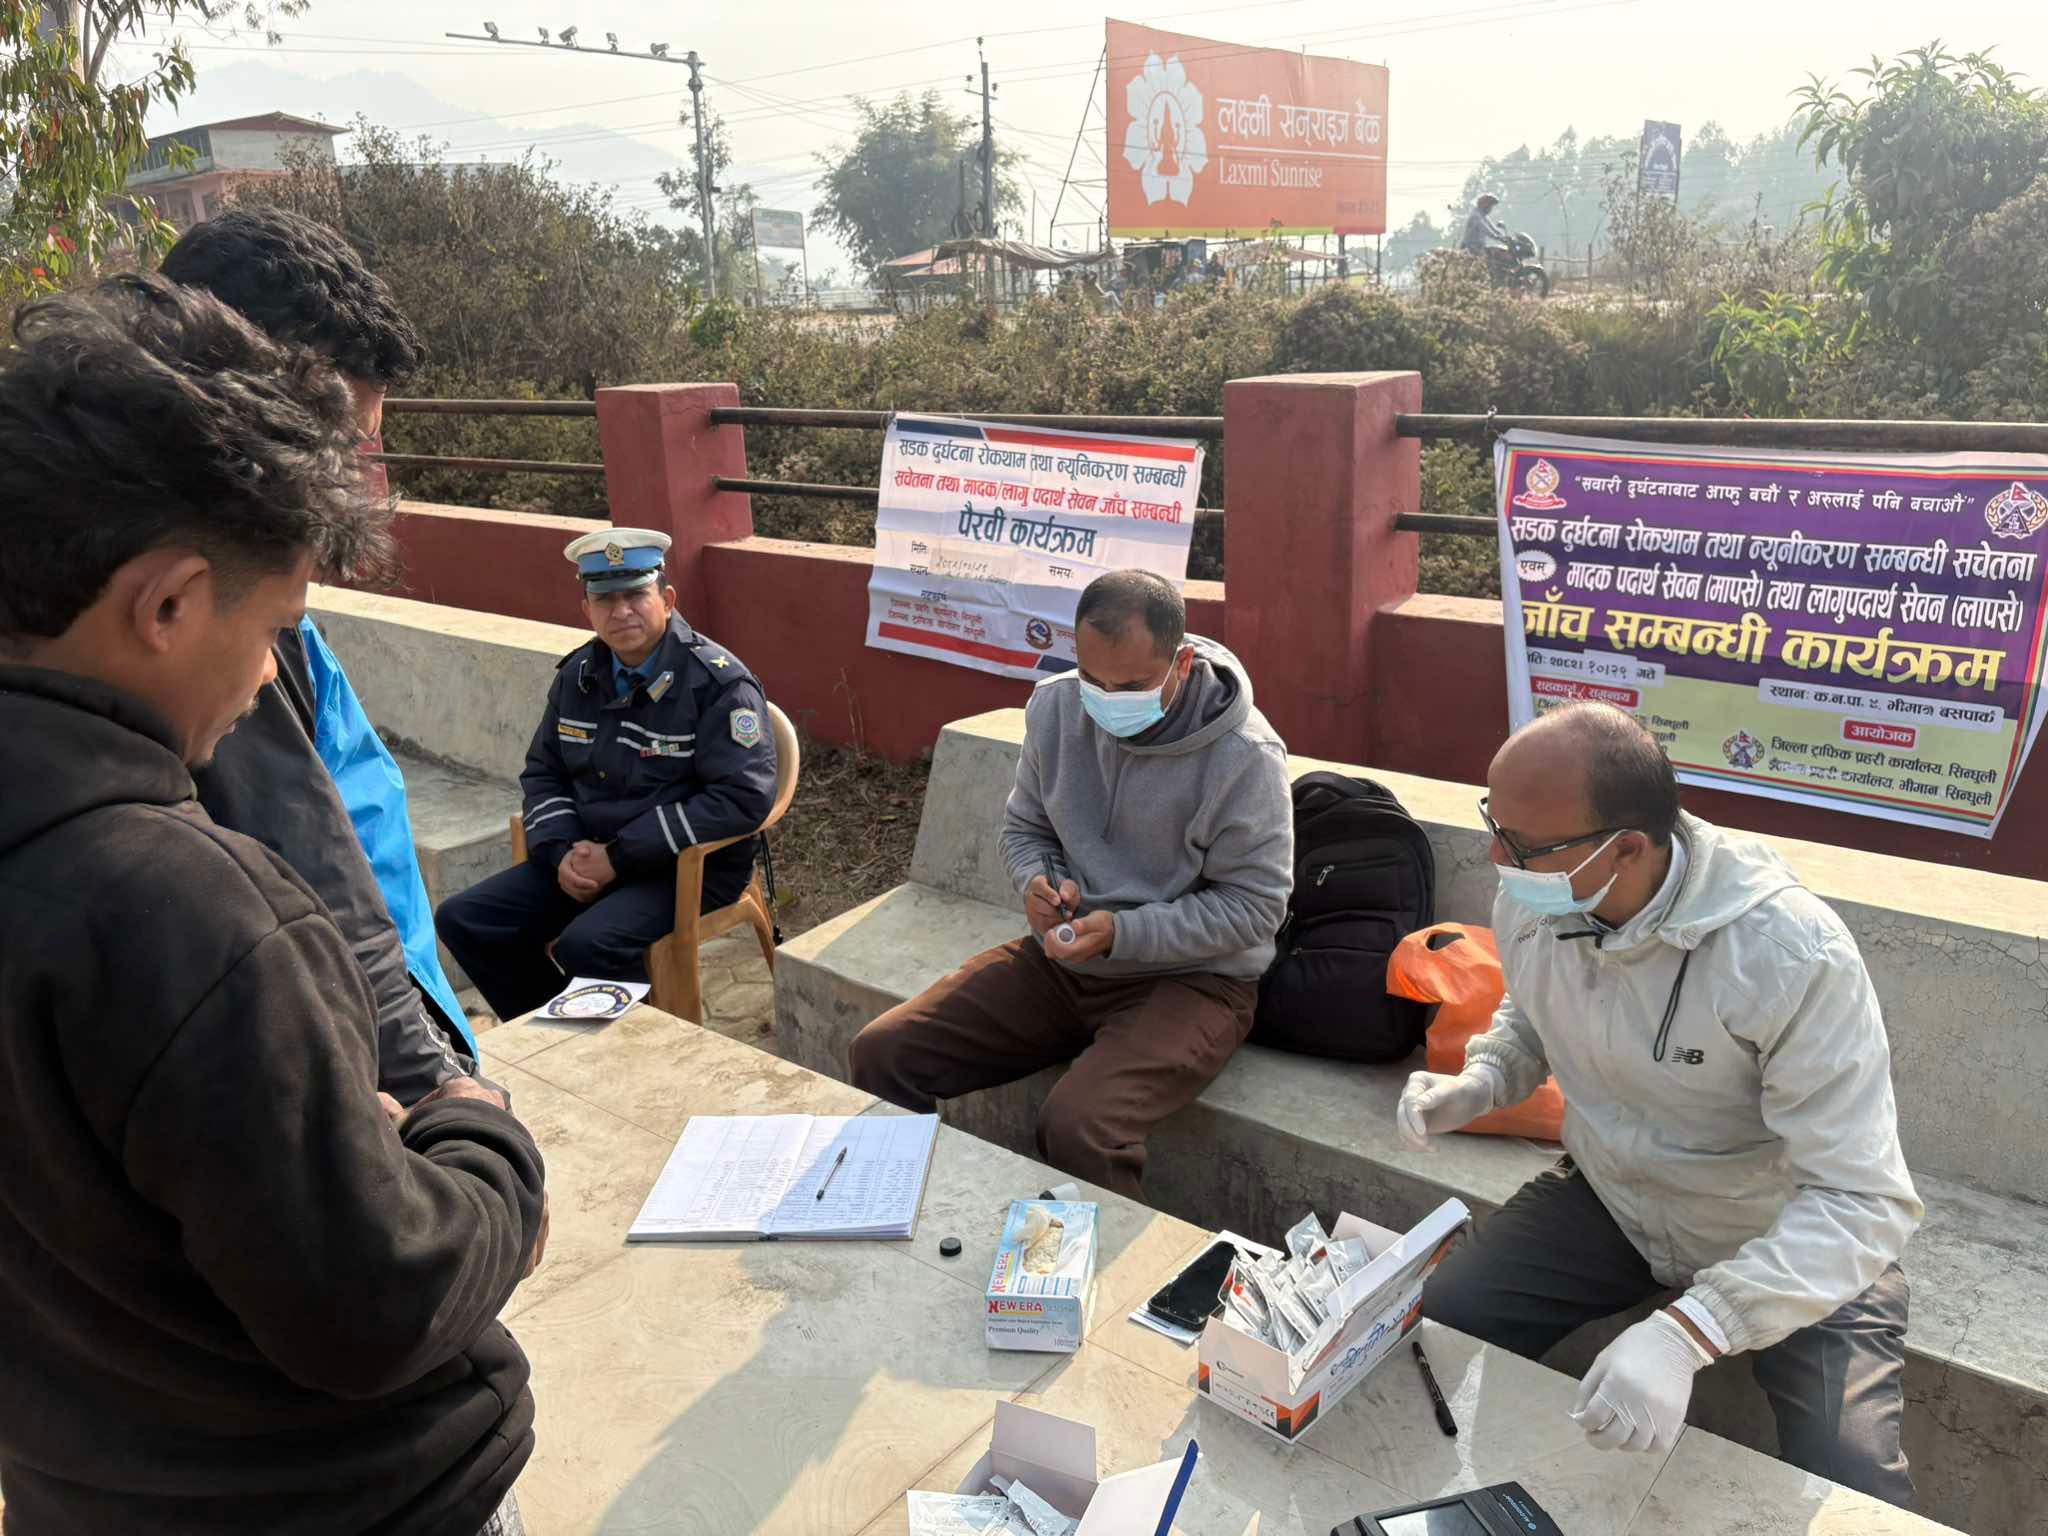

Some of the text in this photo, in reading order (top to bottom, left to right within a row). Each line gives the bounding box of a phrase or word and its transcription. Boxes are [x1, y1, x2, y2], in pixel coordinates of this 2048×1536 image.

[1216, 94, 1272, 139] लक्ष्मी
[1219, 157, 1322, 188] Laxmi Sunrise
[899, 439, 930, 456] सडक
[932, 440, 976, 464] दुर्घटना
[978, 443, 1026, 471] रोकथाम
[1030, 453, 1053, 472] तथा
[1133, 464, 1187, 488] सम्बन्धी
[936, 475, 960, 493] तथा
[1032, 487, 1065, 507] पदार्थ
[1068, 488, 1098, 511] सेवन
[1099, 489, 1127, 515] जाँच
[1131, 500, 1183, 524] सम्बन्धी
[1627, 477, 1699, 498] दुर्घटनाबाट
[1789, 490, 1800, 507] र
[1872, 490, 1903, 511] पनि
[958, 500, 1098, 557] पैरवी कार्यक्रम
[1511, 515, 2038, 581] सडक दुर्घटना रोकथाम तथा न्यूनीकरण सम्बन्धी सचेतना
[1566, 561, 2024, 632] मादक पदार्थ सेवन (मापसे) तथा लागुपदार्थ सेवन (लापसे)
[1521, 585, 2006, 692] जाँच सम्बन्धी कार्यक्रम
[1851, 725, 1912, 743] आयोजक
[1771, 736, 1808, 754] जिल्ला
[1811, 744, 1851, 760] ट्राफिक
[1855, 751, 1885, 766] प्रहरी
[1948, 762, 1998, 784] सिन्धुली
[1945, 784, 1992, 807] सिन्धुली
[988, 1300, 1017, 1313] NEW
[1019, 1301, 1043, 1312] ERA
[1017, 1326, 1040, 1335] Quality
